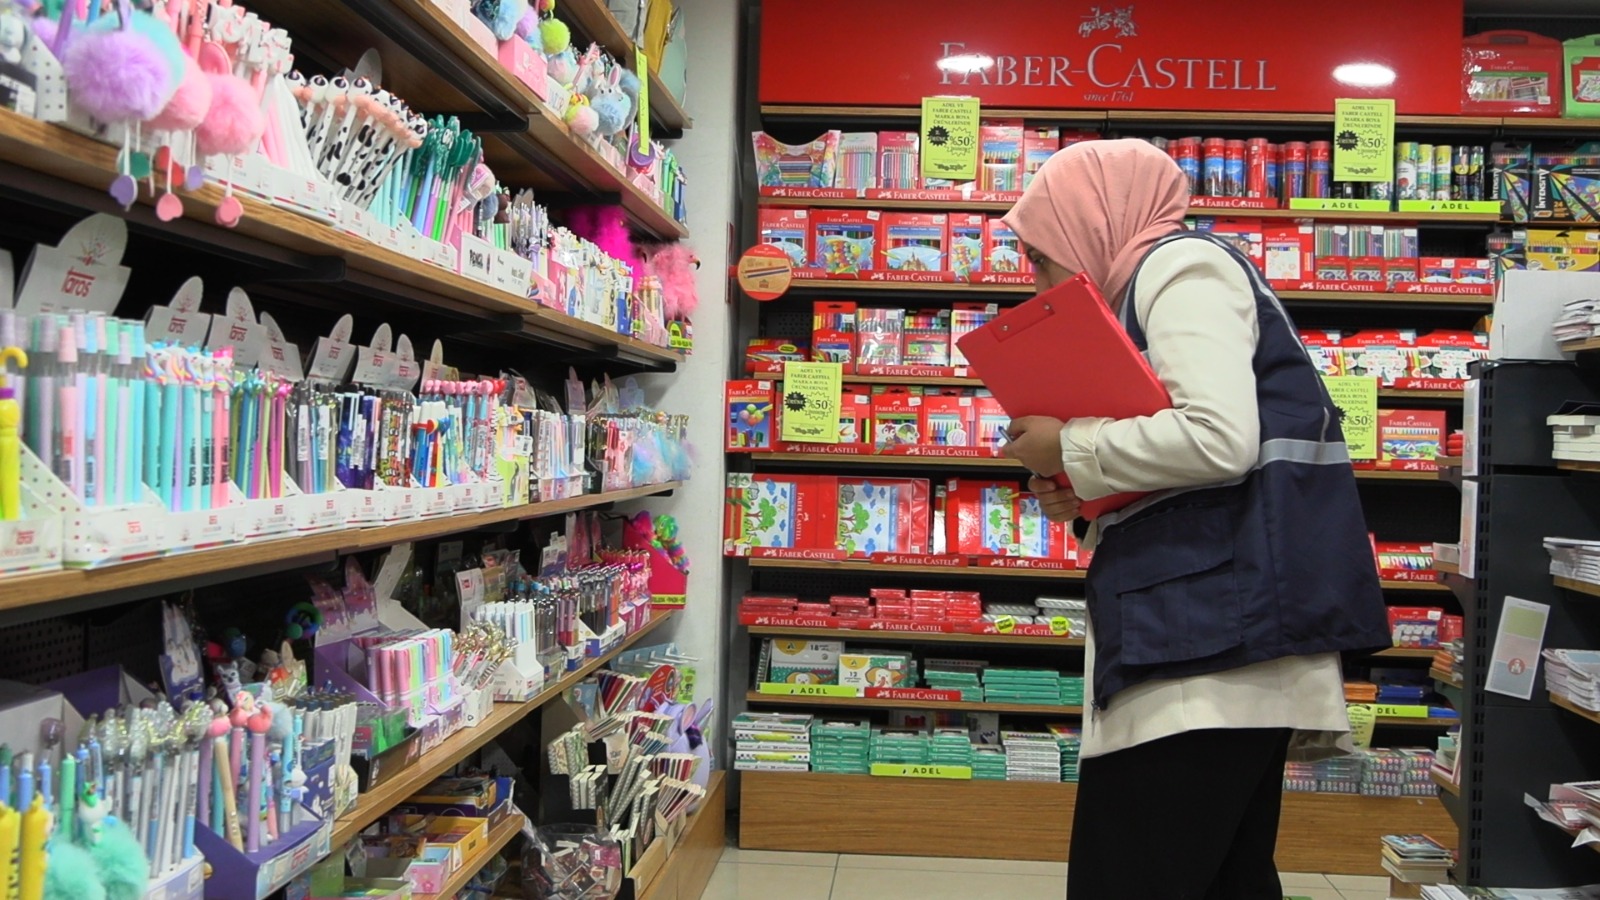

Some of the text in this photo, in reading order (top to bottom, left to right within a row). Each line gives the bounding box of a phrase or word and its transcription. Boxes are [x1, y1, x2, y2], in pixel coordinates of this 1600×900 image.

[1083, 90, 1134, 103] since 1761
[950, 136, 970, 146] %50
[1360, 137, 1381, 148] %50
[787, 188, 844, 198] FABER-CASTELL
[894, 191, 950, 200] FABER-CASTELL
[886, 274, 943, 282] FABER-CASTELL
[998, 274, 1034, 284] FABER-CA
[1316, 282, 1374, 292] FABER-CASTELL
[1424, 284, 1482, 294] FABER-CASTELL
[886, 368, 943, 376] FABER-CASTELL
[808, 400, 828, 410] %50
[1346, 415, 1368, 426] %50
[1389, 420, 1432, 428] FABER-CASTELL
[802, 446, 858, 454] FABER-CASTELL
[922, 448, 980, 457] FABER-CASTELL
[778, 550, 836, 559] FABER-CASTELL
[900, 556, 956, 566] FABER-CASTELL
[1006, 560, 1064, 569] FAR-CASTELL
[770, 617, 828, 627] FABER-CASTELL
[886, 622, 942, 632] FABER-CASTELL
[892, 691, 949, 700] FABER-CASTELL
